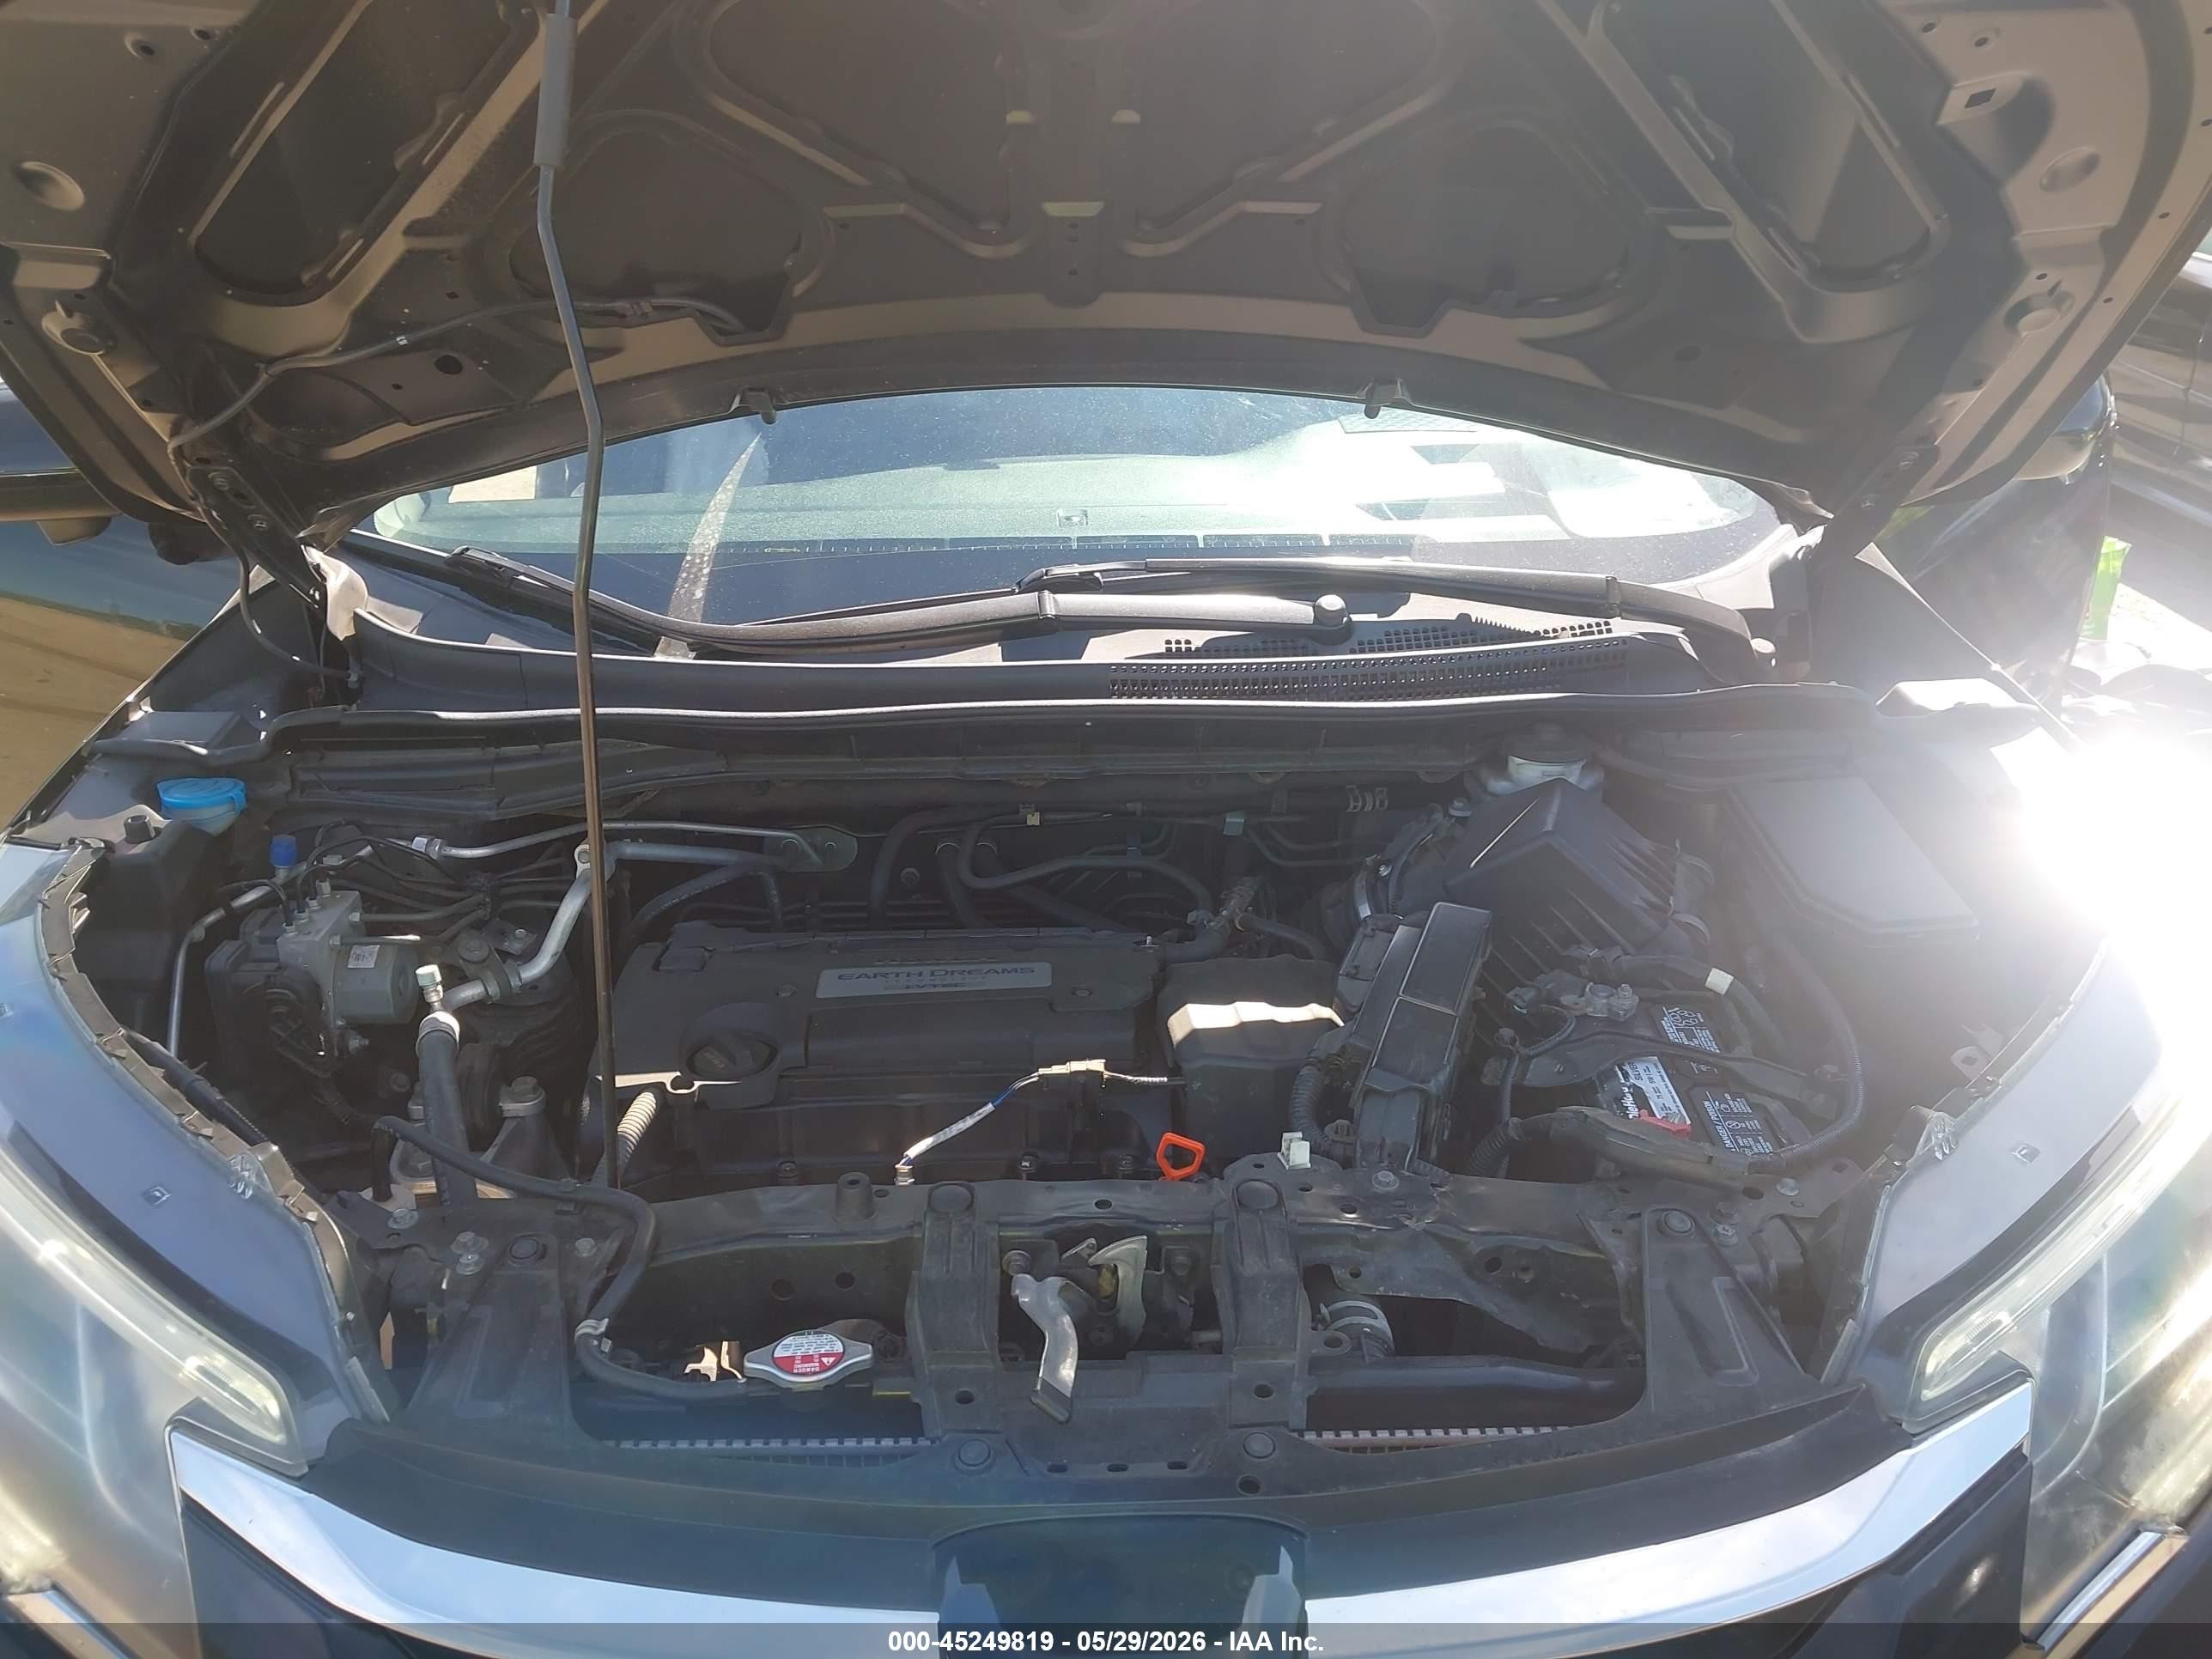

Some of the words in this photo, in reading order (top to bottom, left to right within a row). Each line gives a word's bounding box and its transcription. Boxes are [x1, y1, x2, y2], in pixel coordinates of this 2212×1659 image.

[837, 970, 923, 981] EARTH
[930, 967, 1036, 977] DREAMS
[1628, 1061, 1644, 1081] SILVER
[1703, 1100, 1720, 1121] POISON
[1716, 1125, 1735, 1148] DANGER
